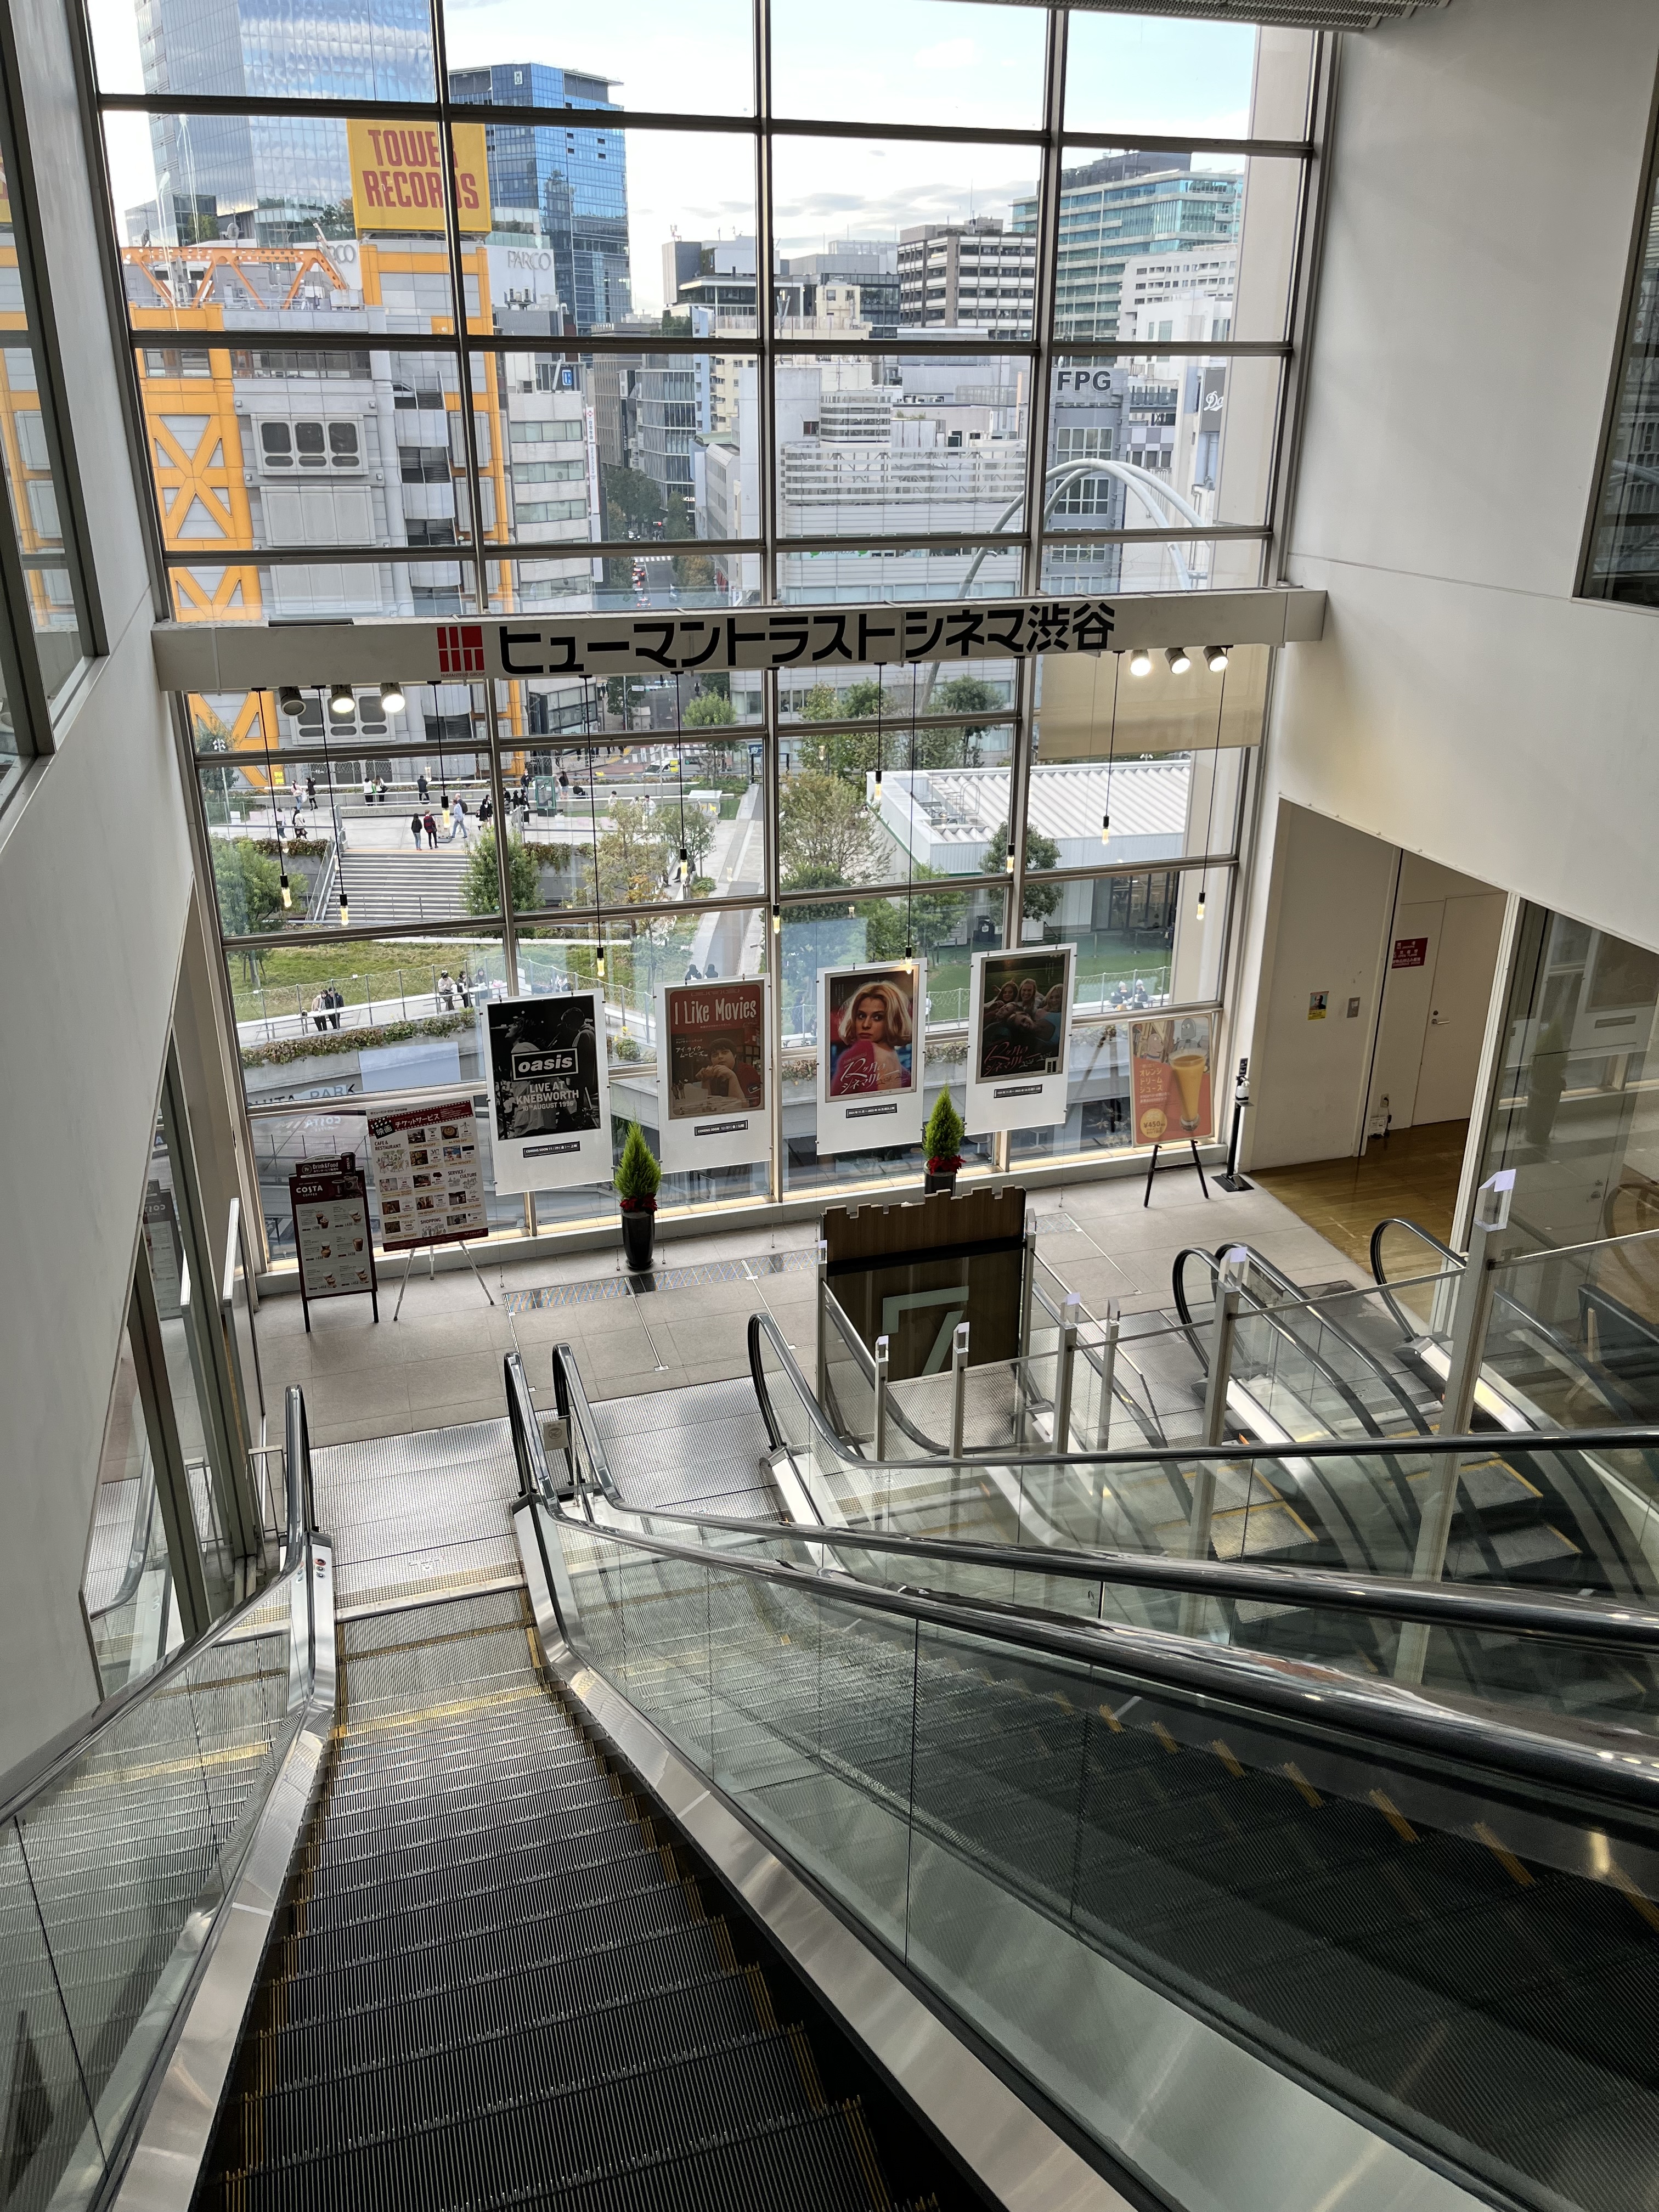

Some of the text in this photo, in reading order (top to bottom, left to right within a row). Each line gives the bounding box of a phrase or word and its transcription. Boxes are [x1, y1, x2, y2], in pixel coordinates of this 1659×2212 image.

[368, 129, 458, 168] TOWE
[507, 250, 551, 270] PARCO
[1057, 371, 1111, 391] FPG
[499, 602, 1115, 675] ヒューマントラストシネマ渋谷
[674, 996, 757, 1025] I Like Movies
[518, 1054, 573, 1073] oasis
[530, 1081, 565, 1093] LIVE AT
[1141, 1076, 1163, 1086] ドリーム
[1139, 1085, 1163, 1093] ジュース
[516, 1090, 579, 1105] KNEBWORTH
[395, 1113, 440, 1128] チケットサービス
[376, 1125, 392, 1136] 映画
[296, 1185, 323, 1193] COSTA
